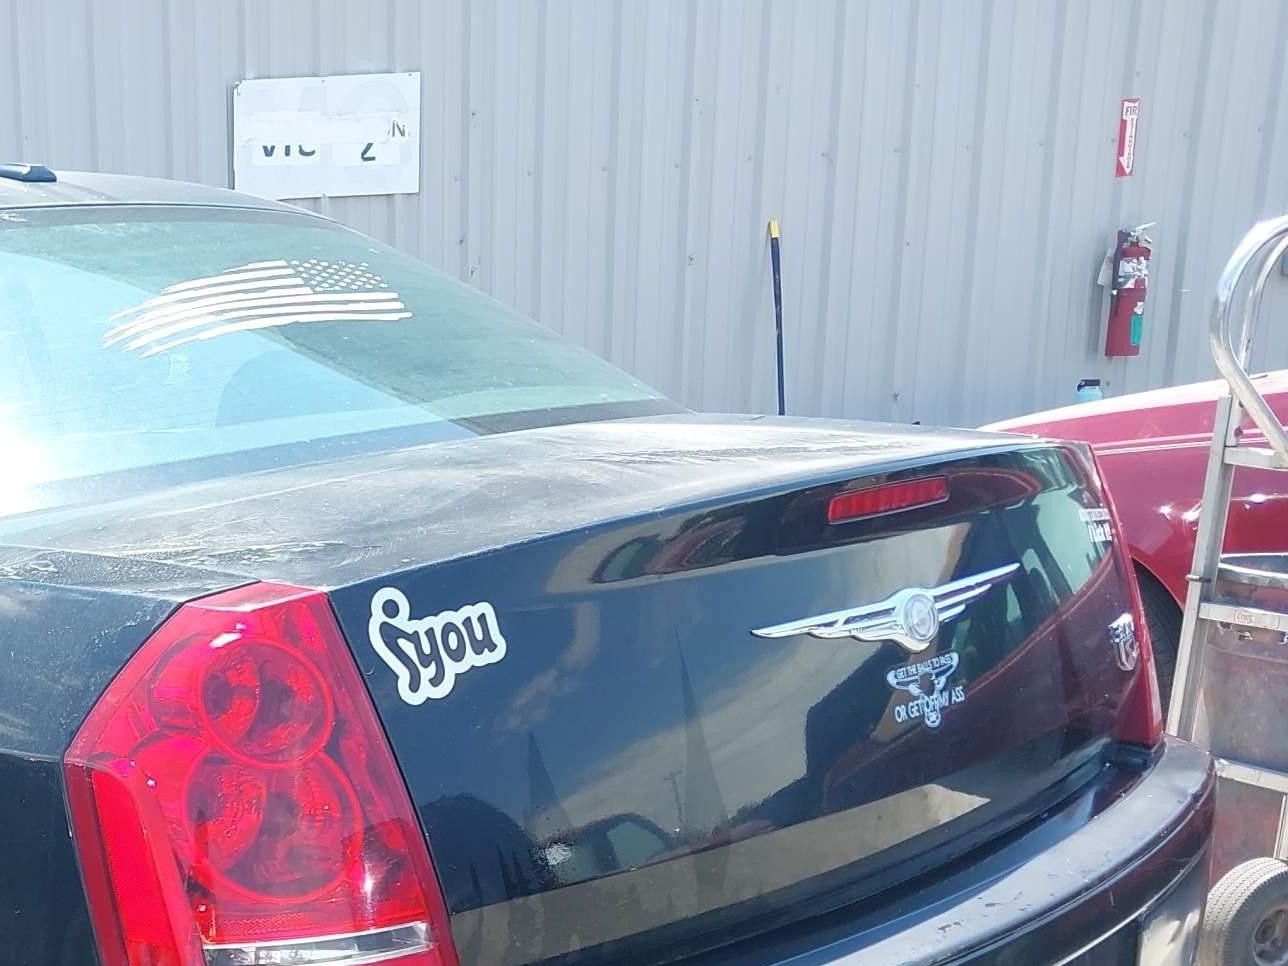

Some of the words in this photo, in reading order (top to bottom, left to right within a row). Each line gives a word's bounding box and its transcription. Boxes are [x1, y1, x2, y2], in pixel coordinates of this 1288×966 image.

[895, 706, 908, 722] OR
[908, 700, 923, 718] GET
[952, 686, 965, 703] ASS
